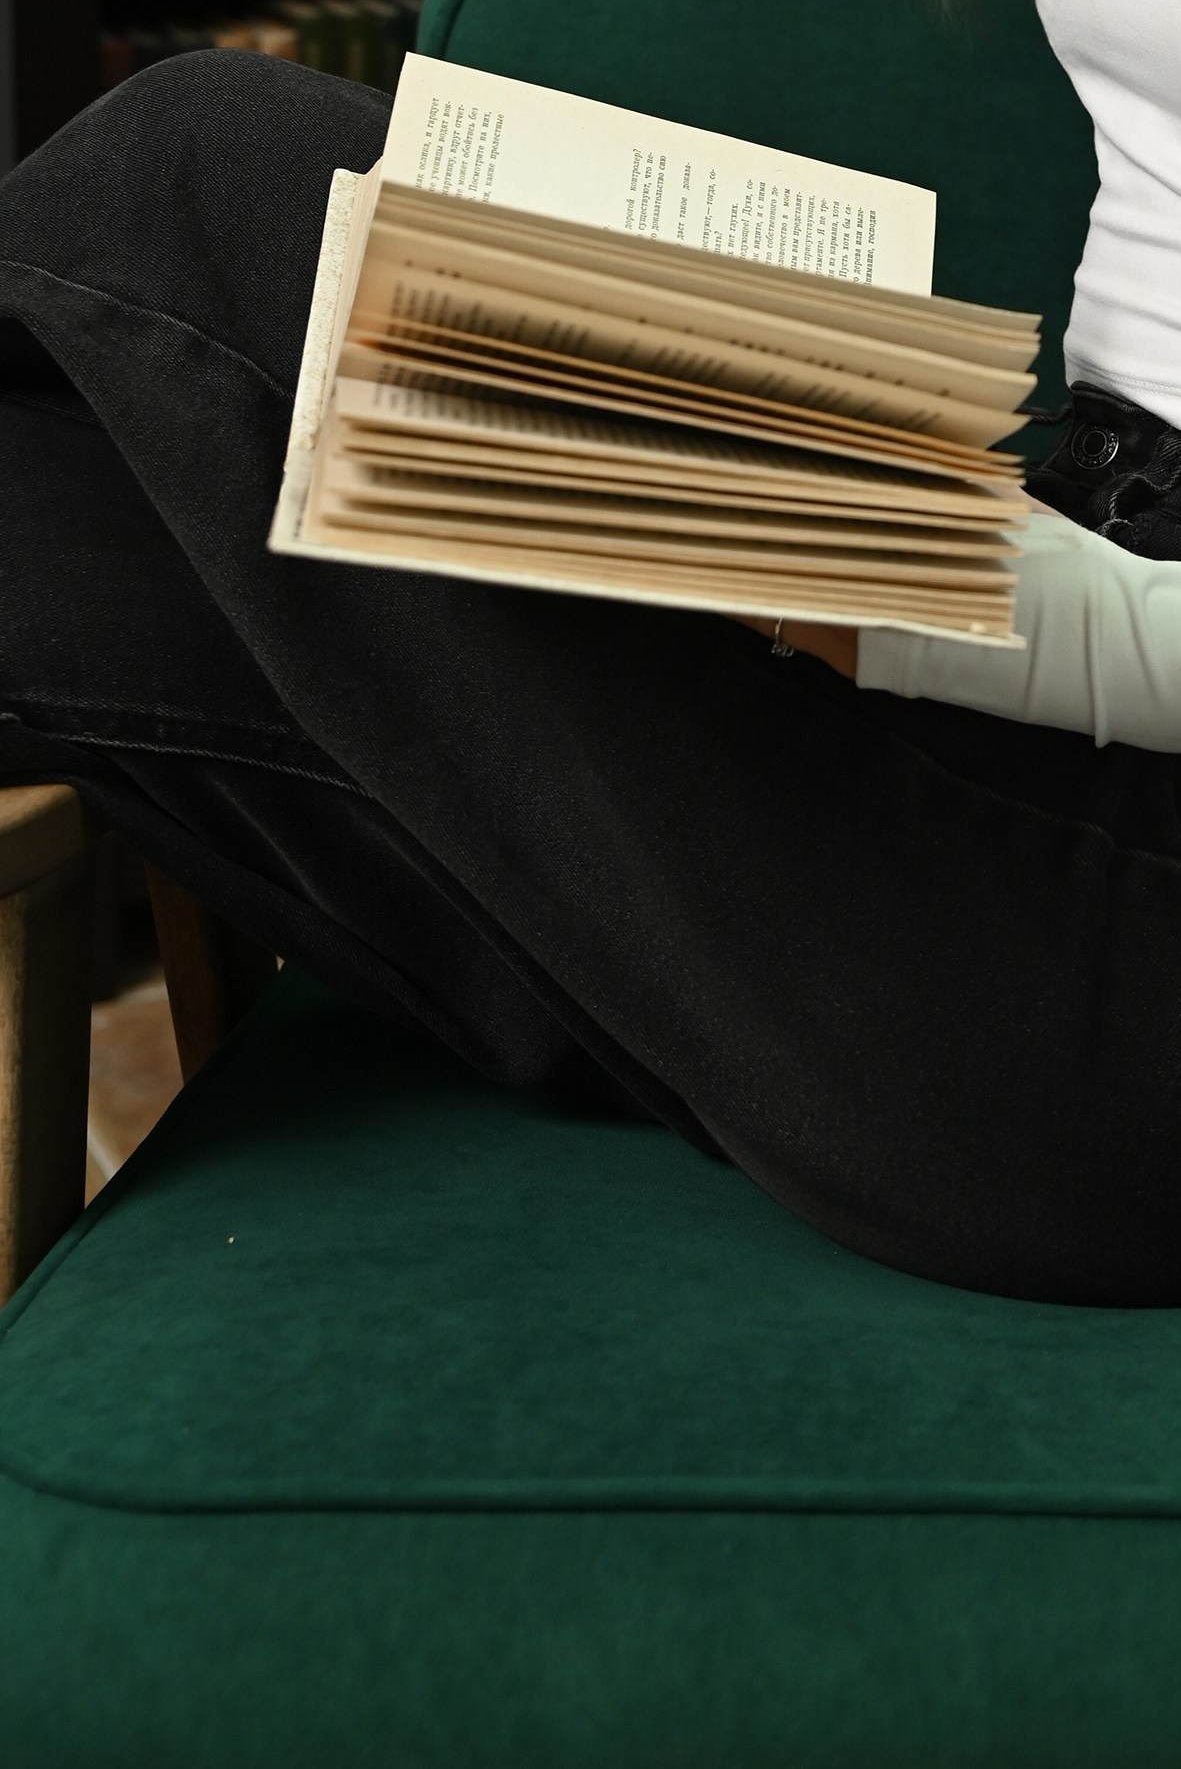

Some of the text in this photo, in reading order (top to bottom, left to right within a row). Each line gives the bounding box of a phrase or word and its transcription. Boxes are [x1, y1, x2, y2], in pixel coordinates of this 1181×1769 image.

[443, 101, 452, 117] вок-
[454, 104, 465, 128] отчет-
[467, 107, 478, 120] без
[481, 111, 492, 128] них,
[418, 141, 432, 170] ослика,
[427, 97, 439, 129] гарцует
[438, 119, 449, 143] водят
[449, 130, 461, 153] вдруг
[461, 122, 475, 158] обойтись
[479, 131, 487, 141] на
[489, 113, 505, 160] прелестные
[431, 145, 444, 180] ученицы
[468, 145, 485, 192] Посмотрите
[646, 152, 654, 164] не-
[457, 160, 468, 185] может
[485, 163, 495, 187] какие
[644, 166, 653, 179] что
[682, 162, 691, 190] доказа-
[746, 178, 754, 190] со-
[624, 148, 643, 230] дорогой контролер?
[651, 172, 665, 231] доказательство
[658, 155, 667, 170] сию
[706, 183, 717, 205] тогда,
[783, 188, 791, 207] моем
[638, 182, 653, 231] существуют,
[679, 196, 688, 218] такое
[741, 193, 754, 216] Духи,
[753, 221, 763, 249] видите,
[758, 181, 766, 201] ними
[792, 191, 803, 236] представит-
[820, 197, 829, 213] тре-
[832, 200, 840, 218] хотя
[729, 203, 739, 232] глухих.
[765, 198, 778, 249] собственного
[803, 195, 816, 261] присутствующих,
[819, 215, 826, 225] не
[856, 206, 864, 229] выле-
[867, 209, 877, 244] господин
[676, 221, 685, 240] даст
[727, 234, 735, 248] нет
[829, 221, 839, 255] кармана,
[838, 203, 852, 277] Пусть хотя бы са-
[855, 230, 863, 245] или
[791, 237, 799, 253] вам
[828, 257, 835, 266] из
[853, 248, 862, 274] дерева
